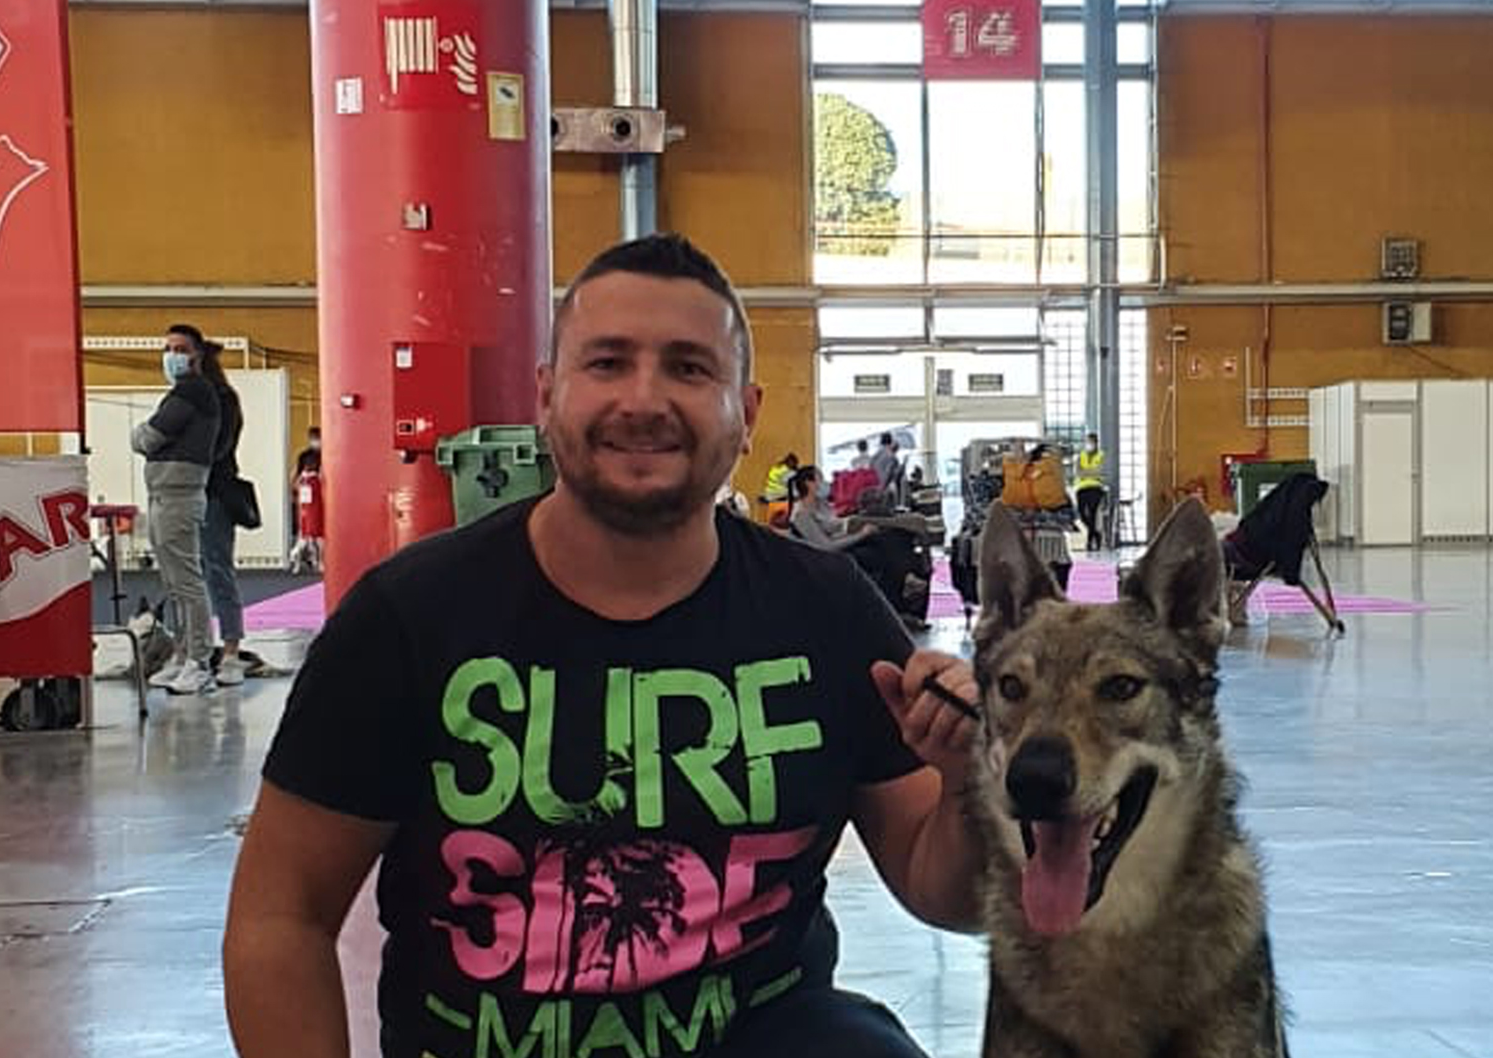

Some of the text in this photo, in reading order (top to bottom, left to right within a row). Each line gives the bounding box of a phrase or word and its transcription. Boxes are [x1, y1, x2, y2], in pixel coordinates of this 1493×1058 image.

[946, 11, 1017, 57] 14
[431, 655, 824, 829] SURF
[429, 827, 819, 994] SIDE
